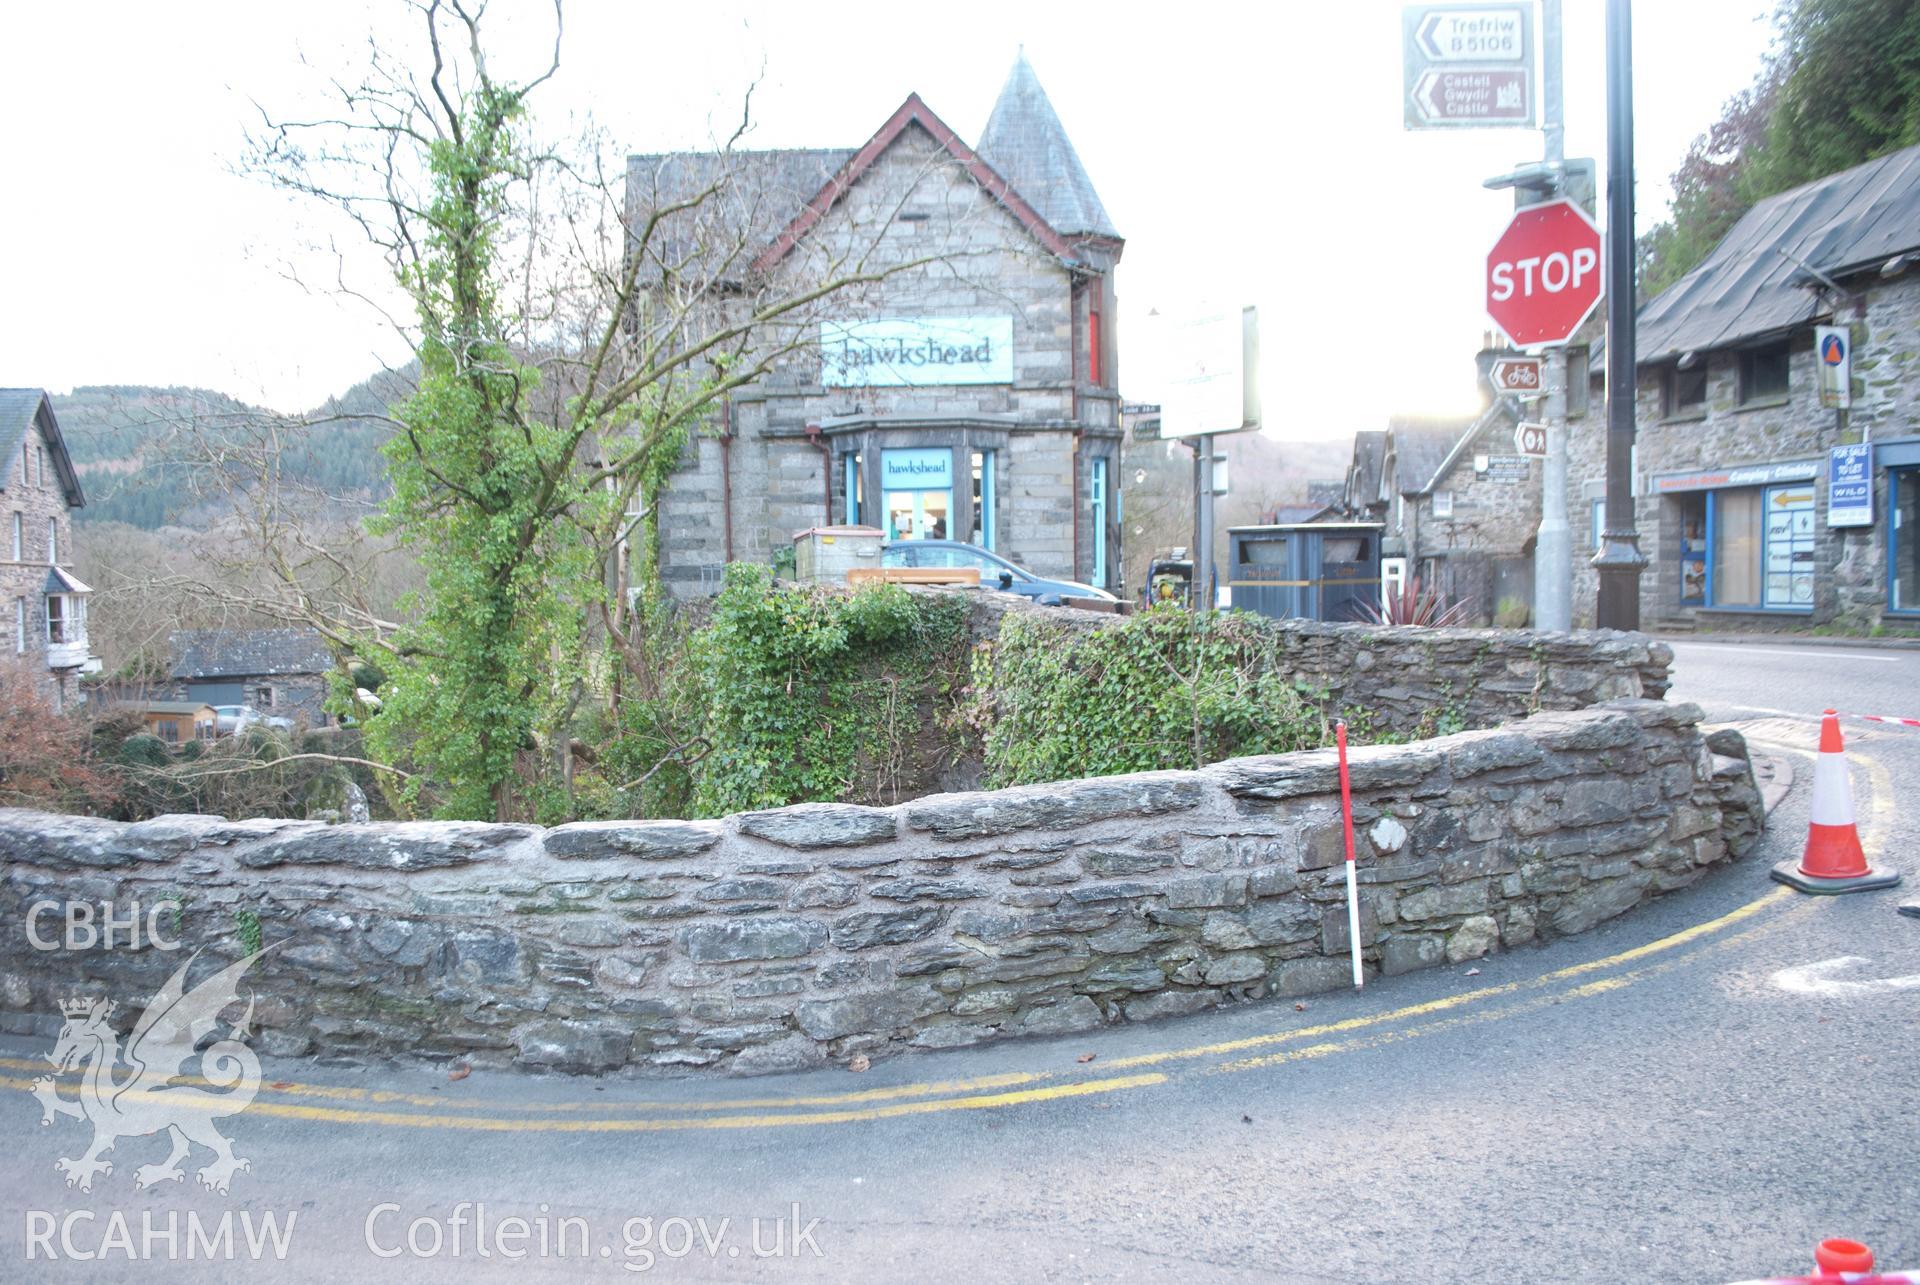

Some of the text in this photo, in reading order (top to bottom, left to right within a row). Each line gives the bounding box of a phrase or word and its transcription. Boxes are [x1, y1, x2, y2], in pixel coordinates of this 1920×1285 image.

[1450, 17, 1515, 33] Trefriw
[1451, 37, 1513, 52] B 5106
[1444, 75, 1490, 88] Castell
[1444, 88, 1490, 102] Gwydir
[1446, 102, 1489, 116] Castle
[1491, 247, 1597, 302] STOP
[843, 337, 992, 367] hawkshead
[888, 460, 946, 475] hawkshead
